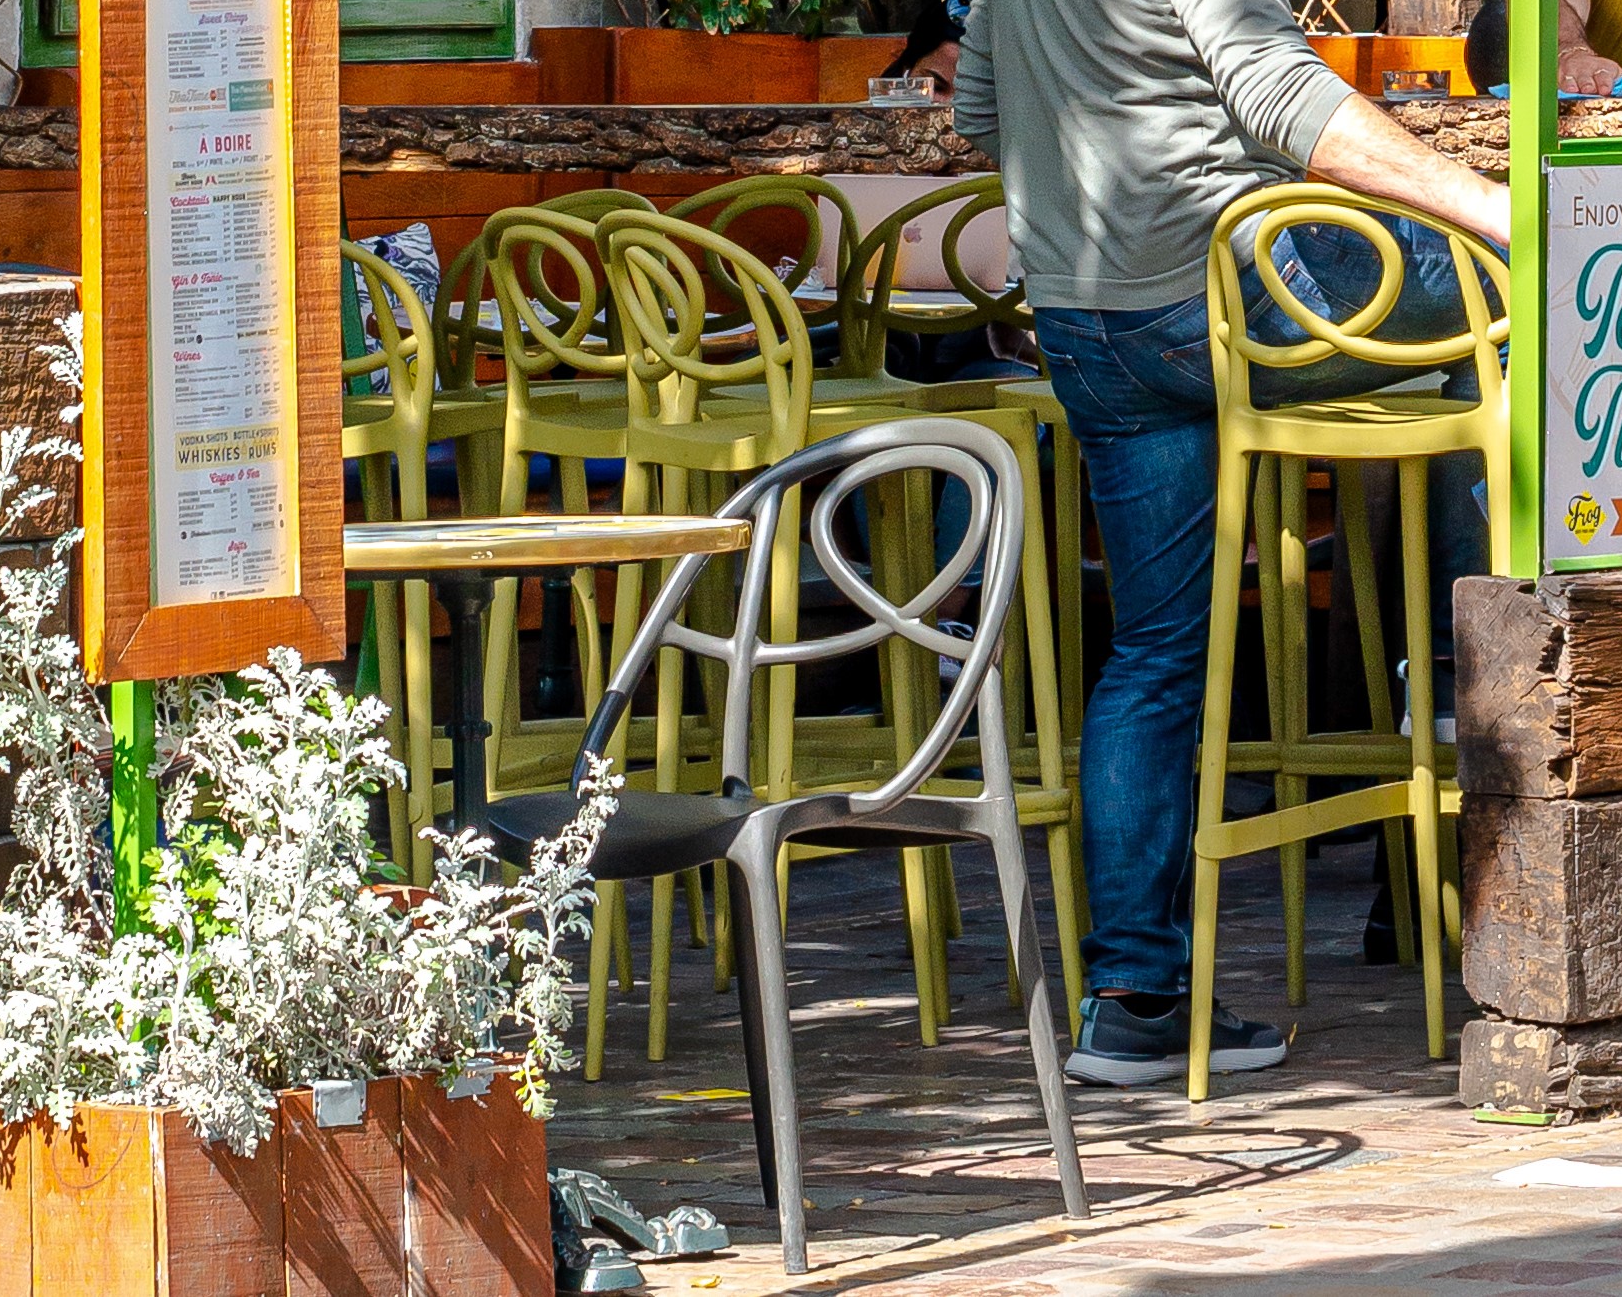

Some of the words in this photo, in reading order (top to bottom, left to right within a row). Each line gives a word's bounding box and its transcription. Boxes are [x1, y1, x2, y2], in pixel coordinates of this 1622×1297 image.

[215, 134, 252, 153] BOIRE
[170, 195, 210, 208] Cocktails
[180, 436, 204, 446] VODKA
[178, 446, 241, 464] WHISKIES
[248, 441, 277, 460] RUMS
[1568, 494, 1601, 531] Frog
